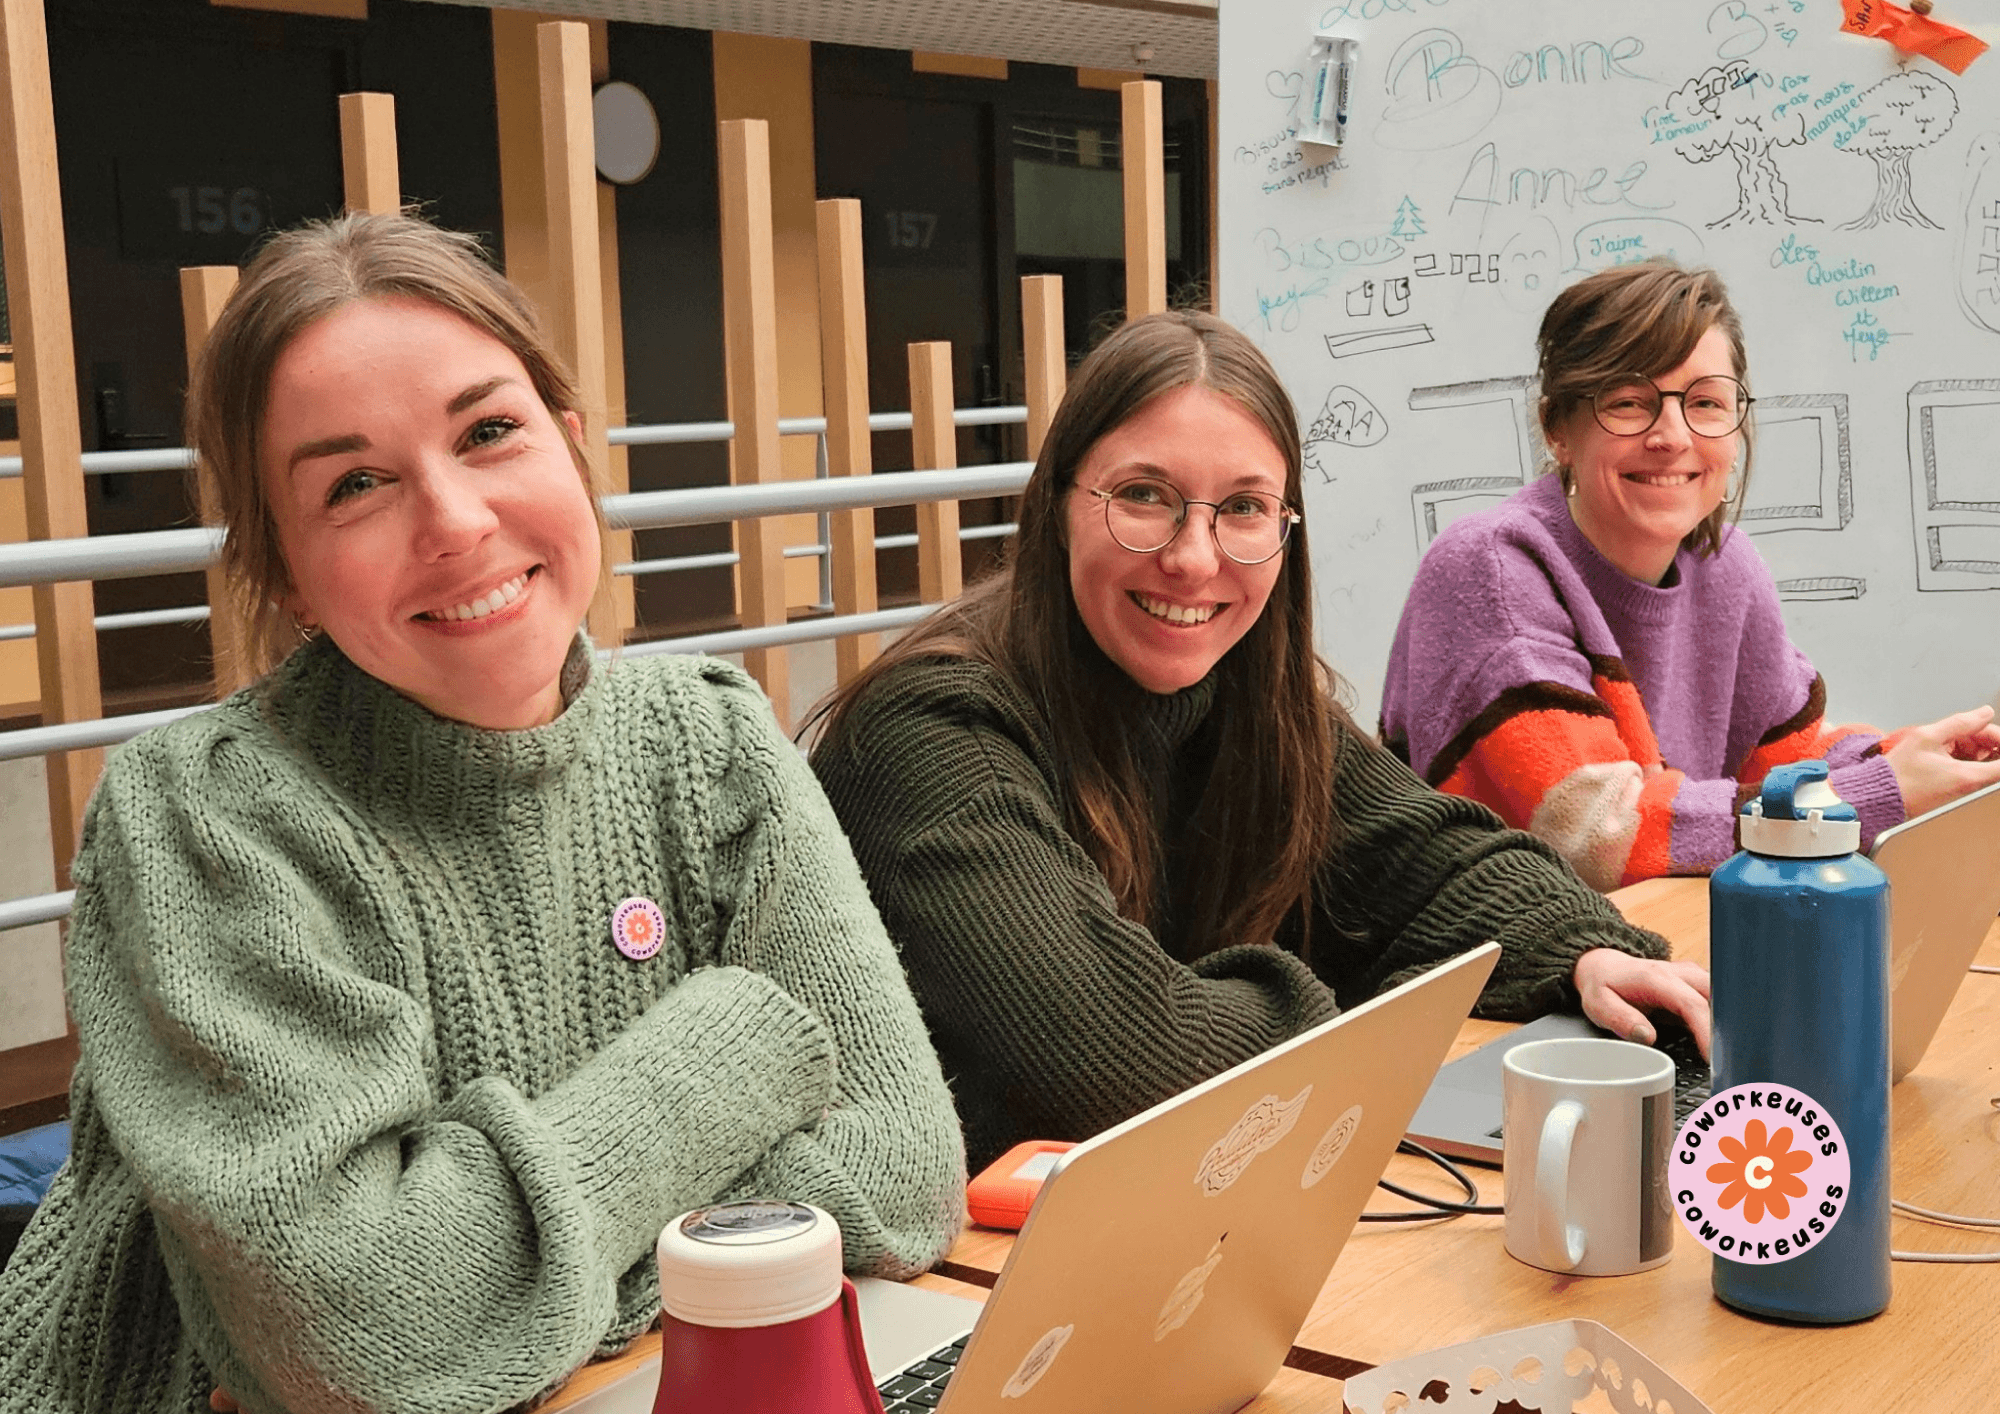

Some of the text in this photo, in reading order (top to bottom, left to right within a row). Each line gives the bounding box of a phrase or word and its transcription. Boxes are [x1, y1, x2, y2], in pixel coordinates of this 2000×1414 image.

[1372, 27, 1676, 151] Bonne
[1813, 81, 1855, 110] nous
[1806, 91, 1867, 142] manquer
[1297, 153, 1350, 189] regret
[170, 185, 262, 234] 156
[884, 210, 939, 249] 157
[1413, 252, 1500, 284] 2026
[1835, 284, 1900, 306] Willem
